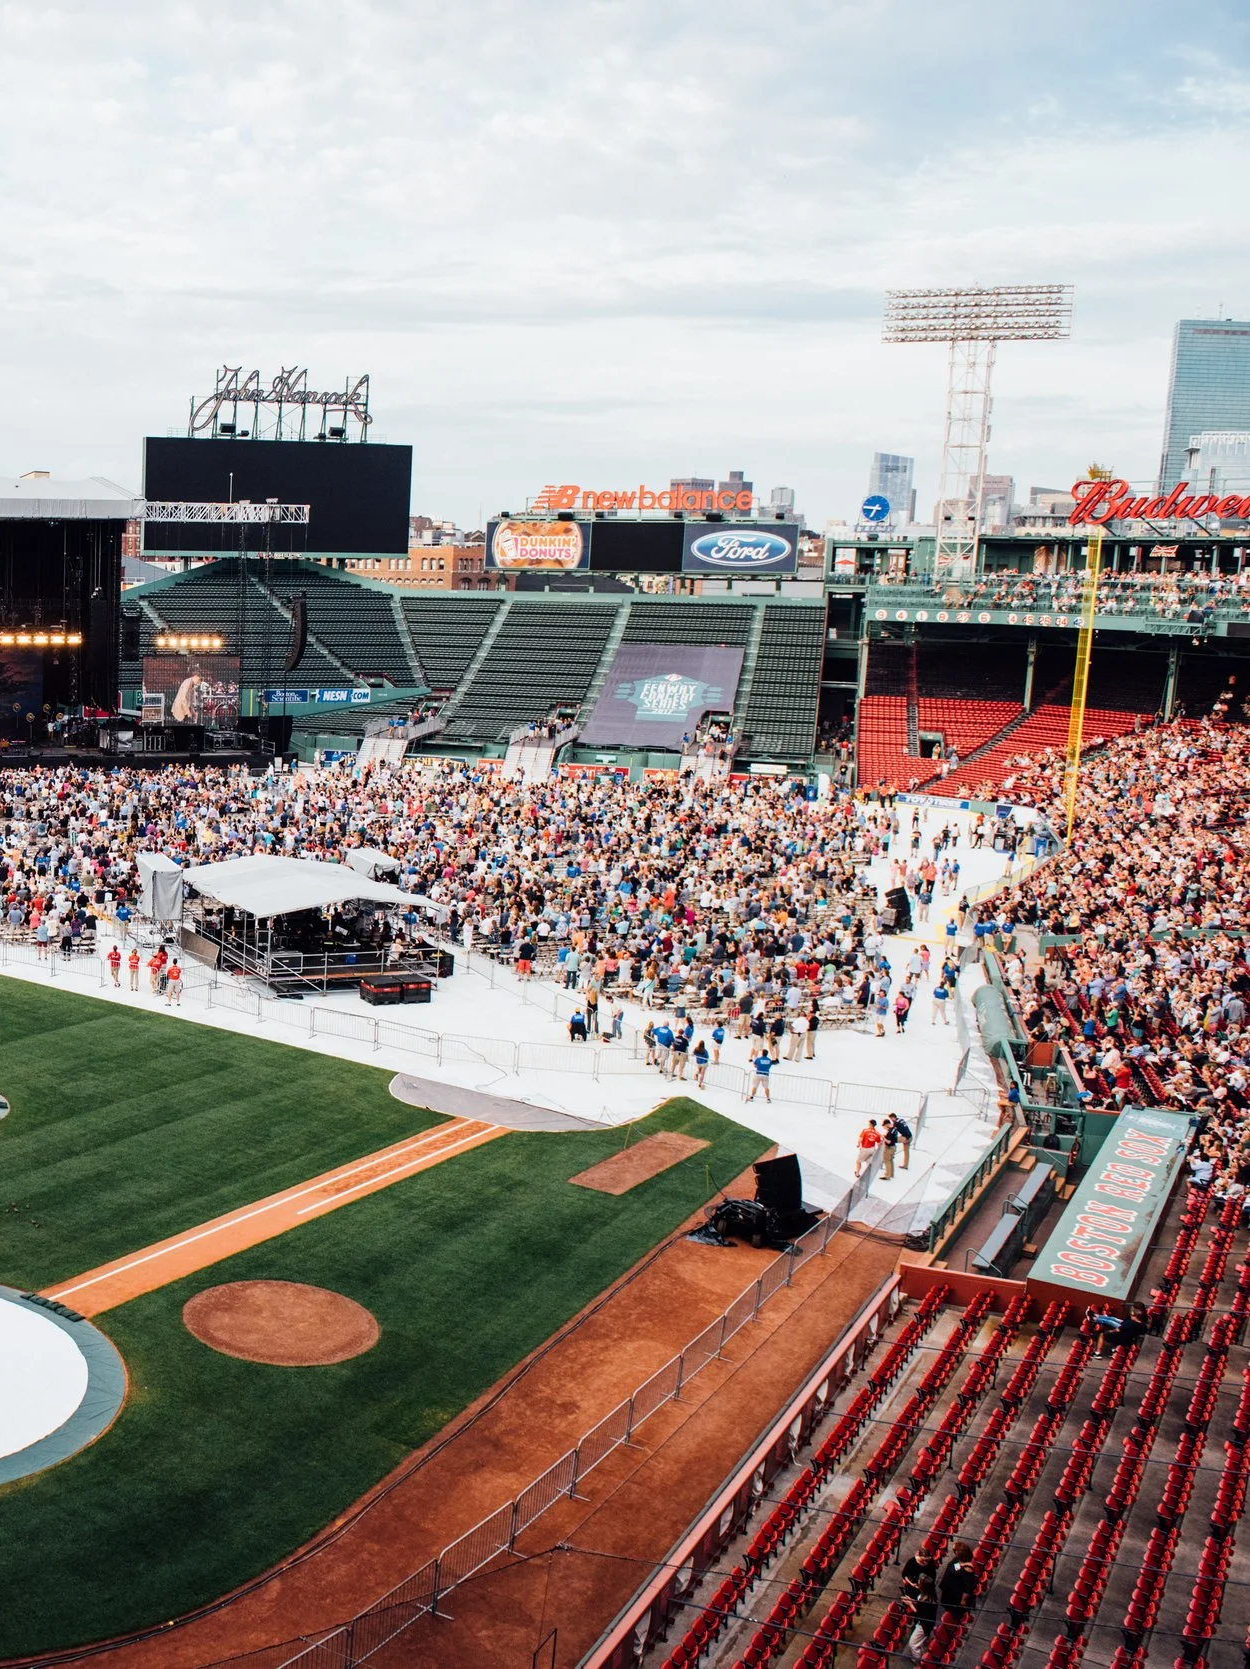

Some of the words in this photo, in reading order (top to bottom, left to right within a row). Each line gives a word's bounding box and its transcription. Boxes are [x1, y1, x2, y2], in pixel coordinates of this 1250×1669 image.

[190, 364, 263, 431] John
[262, 365, 373, 425] Hancock
[582, 489, 637, 510] new
[639, 484, 753, 510] balance
[519, 536, 576, 548] DUNKIN'
[519, 547, 571, 558] DONUTS
[710, 536, 769, 559] Ford
[877, 610, 884, 619] 9
[898, 611, 905, 620] 4
[644, 682, 697, 695] FENWAY
[644, 699, 687, 709] SERIES
[1114, 1127, 1174, 1166] SOX
[1094, 1162, 1156, 1203] RED
[1050, 1200, 1138, 1287] BOSTON
